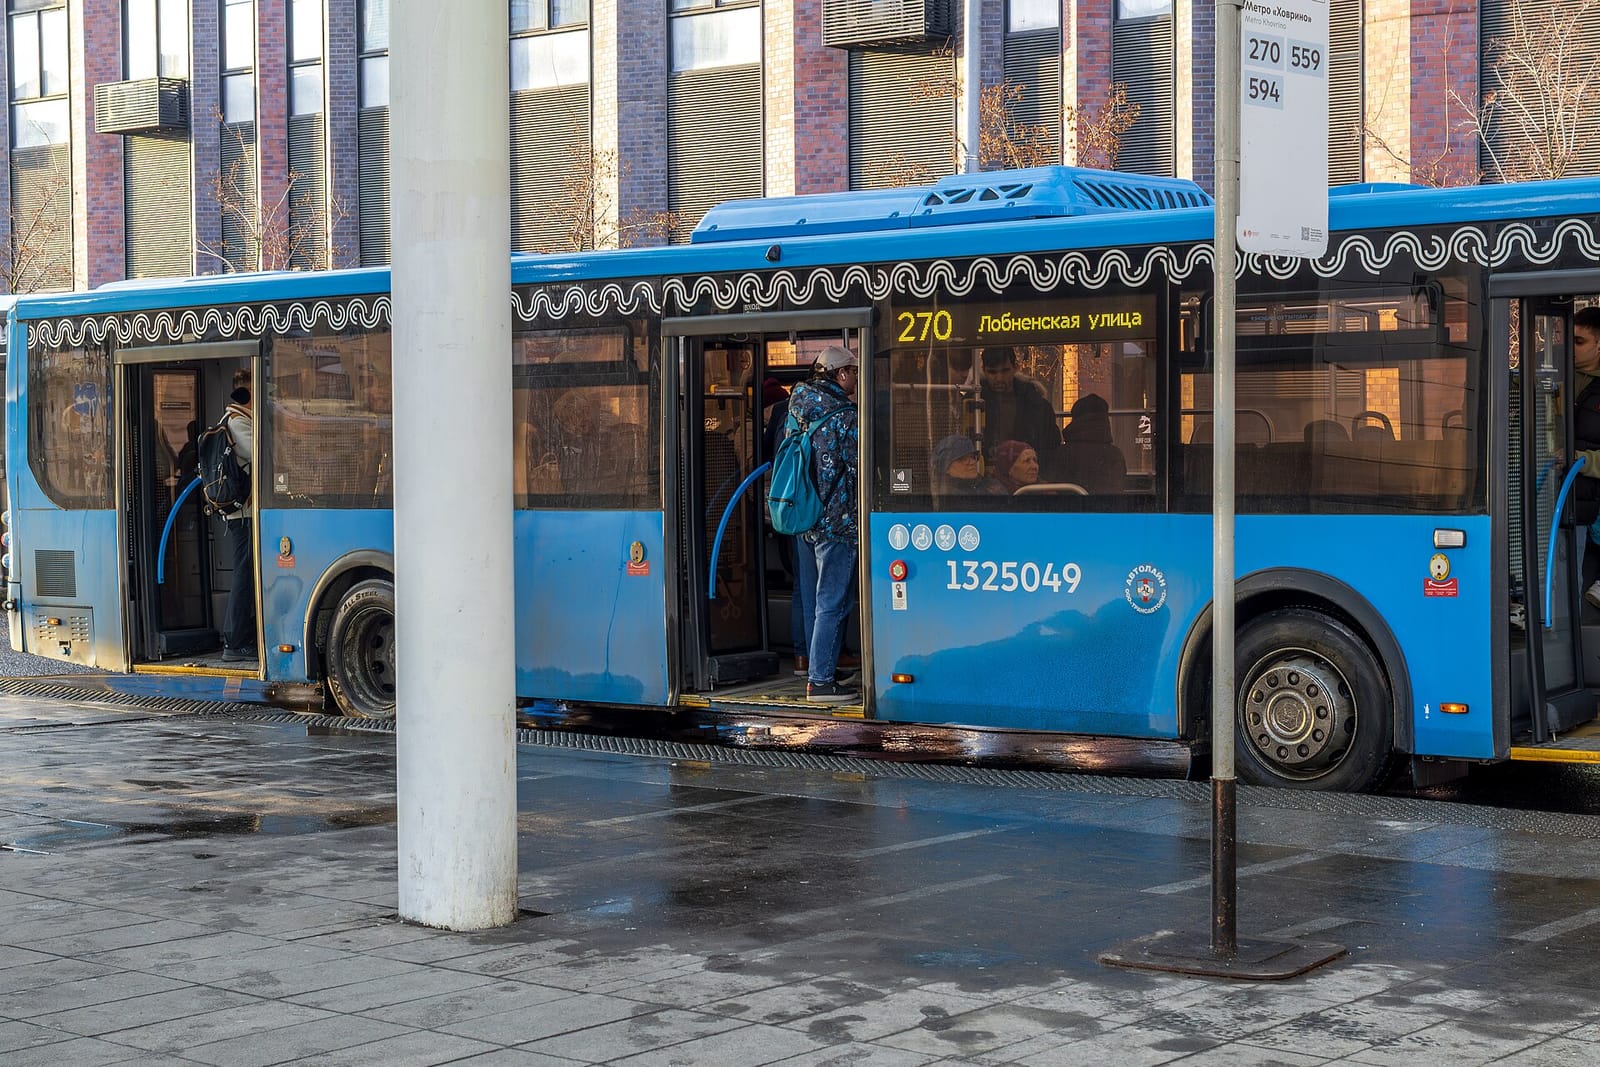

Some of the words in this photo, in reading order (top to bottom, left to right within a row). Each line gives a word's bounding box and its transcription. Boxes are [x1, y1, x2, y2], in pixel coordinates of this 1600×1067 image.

[1245, 1, 1271, 15] Метро
[1272, 7, 1312, 23] «Ховрино»
[1245, 15, 1262, 25] Metro
[1263, 19, 1287, 30] Khovrino
[1249, 38, 1281, 64] 270
[1291, 46, 1321, 71] 559
[1249, 78, 1280, 103] 594
[897, 310, 953, 343] 270
[978, 312, 1080, 333] Лобненская
[1089, 310, 1142, 330] улица
[946, 560, 1082, 594] 1325049
[1126, 565, 1165, 586] АВТОЛАЙН
